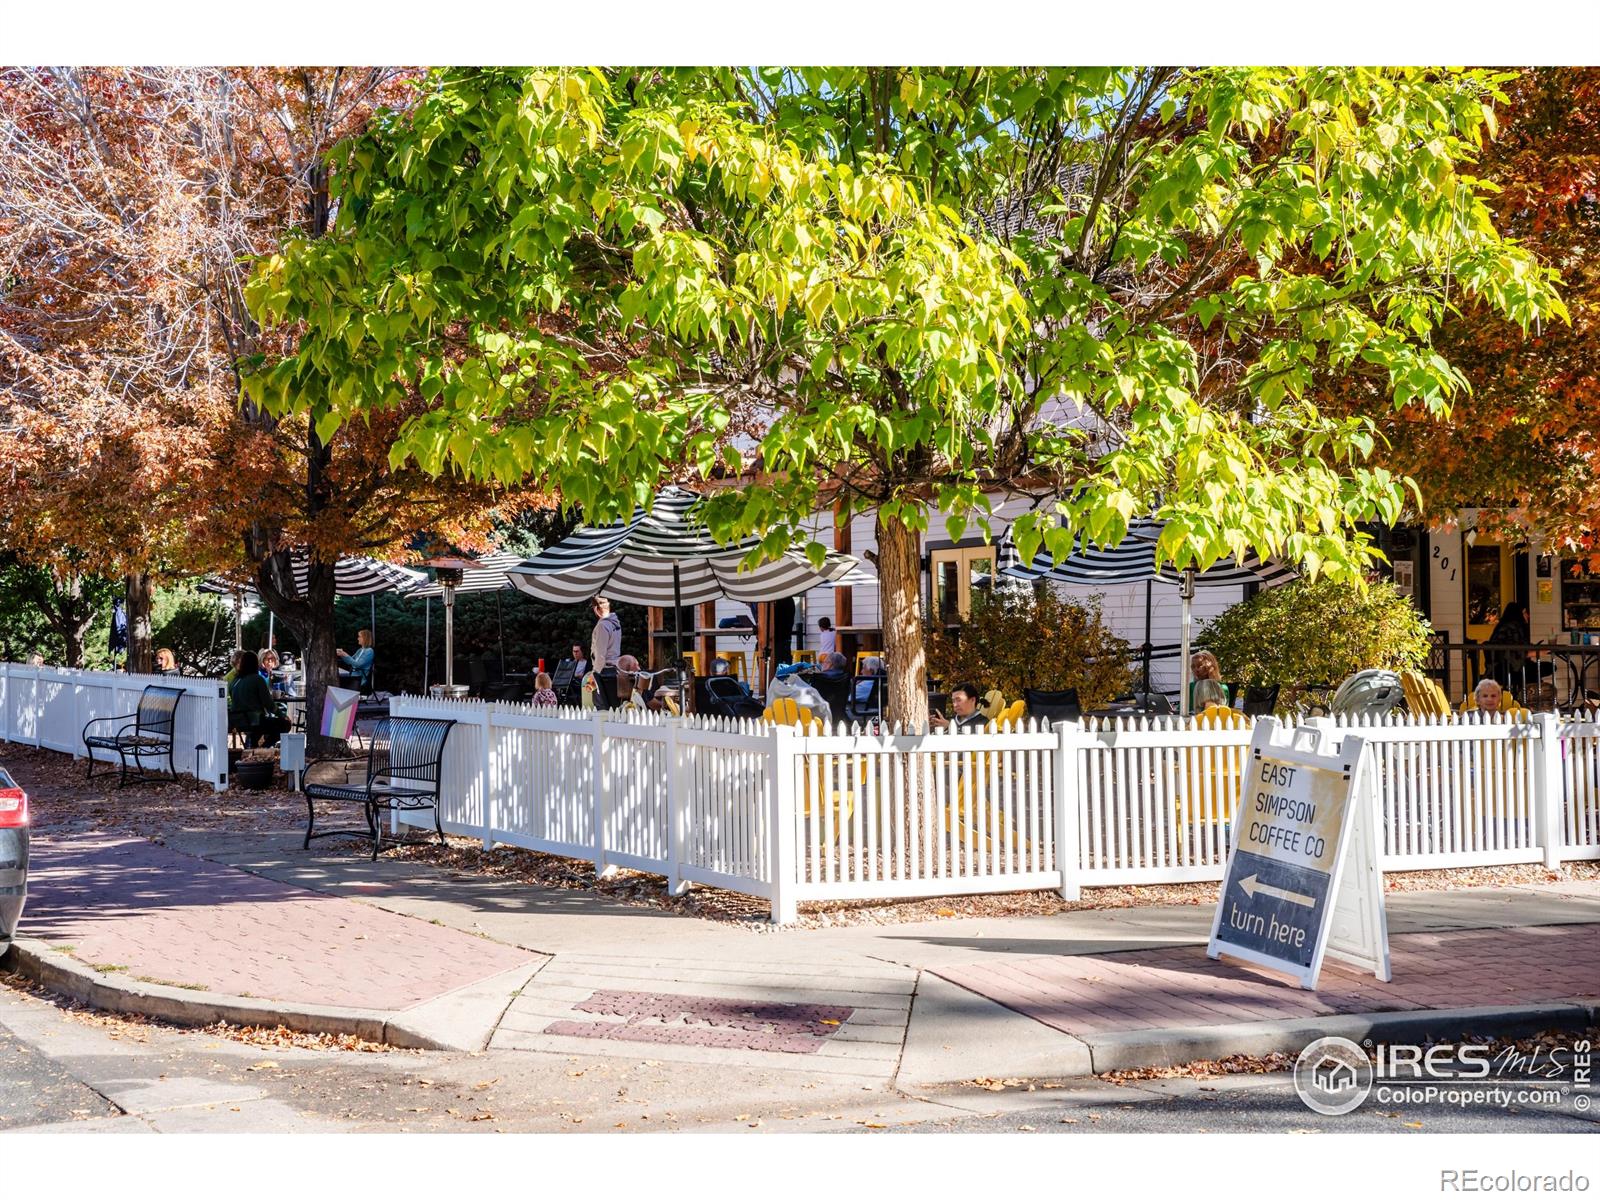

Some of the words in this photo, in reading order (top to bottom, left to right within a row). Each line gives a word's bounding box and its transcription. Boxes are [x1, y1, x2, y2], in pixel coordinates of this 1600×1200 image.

[1433, 546, 1456, 581] 201
[1261, 763, 1296, 788] EAST
[1255, 793, 1316, 824] SIMPSON
[1250, 822, 1301, 851] COFFEE
[1305, 835, 1325, 858] CO
[1231, 902, 1264, 936] turn
[1268, 915, 1306, 947] here
